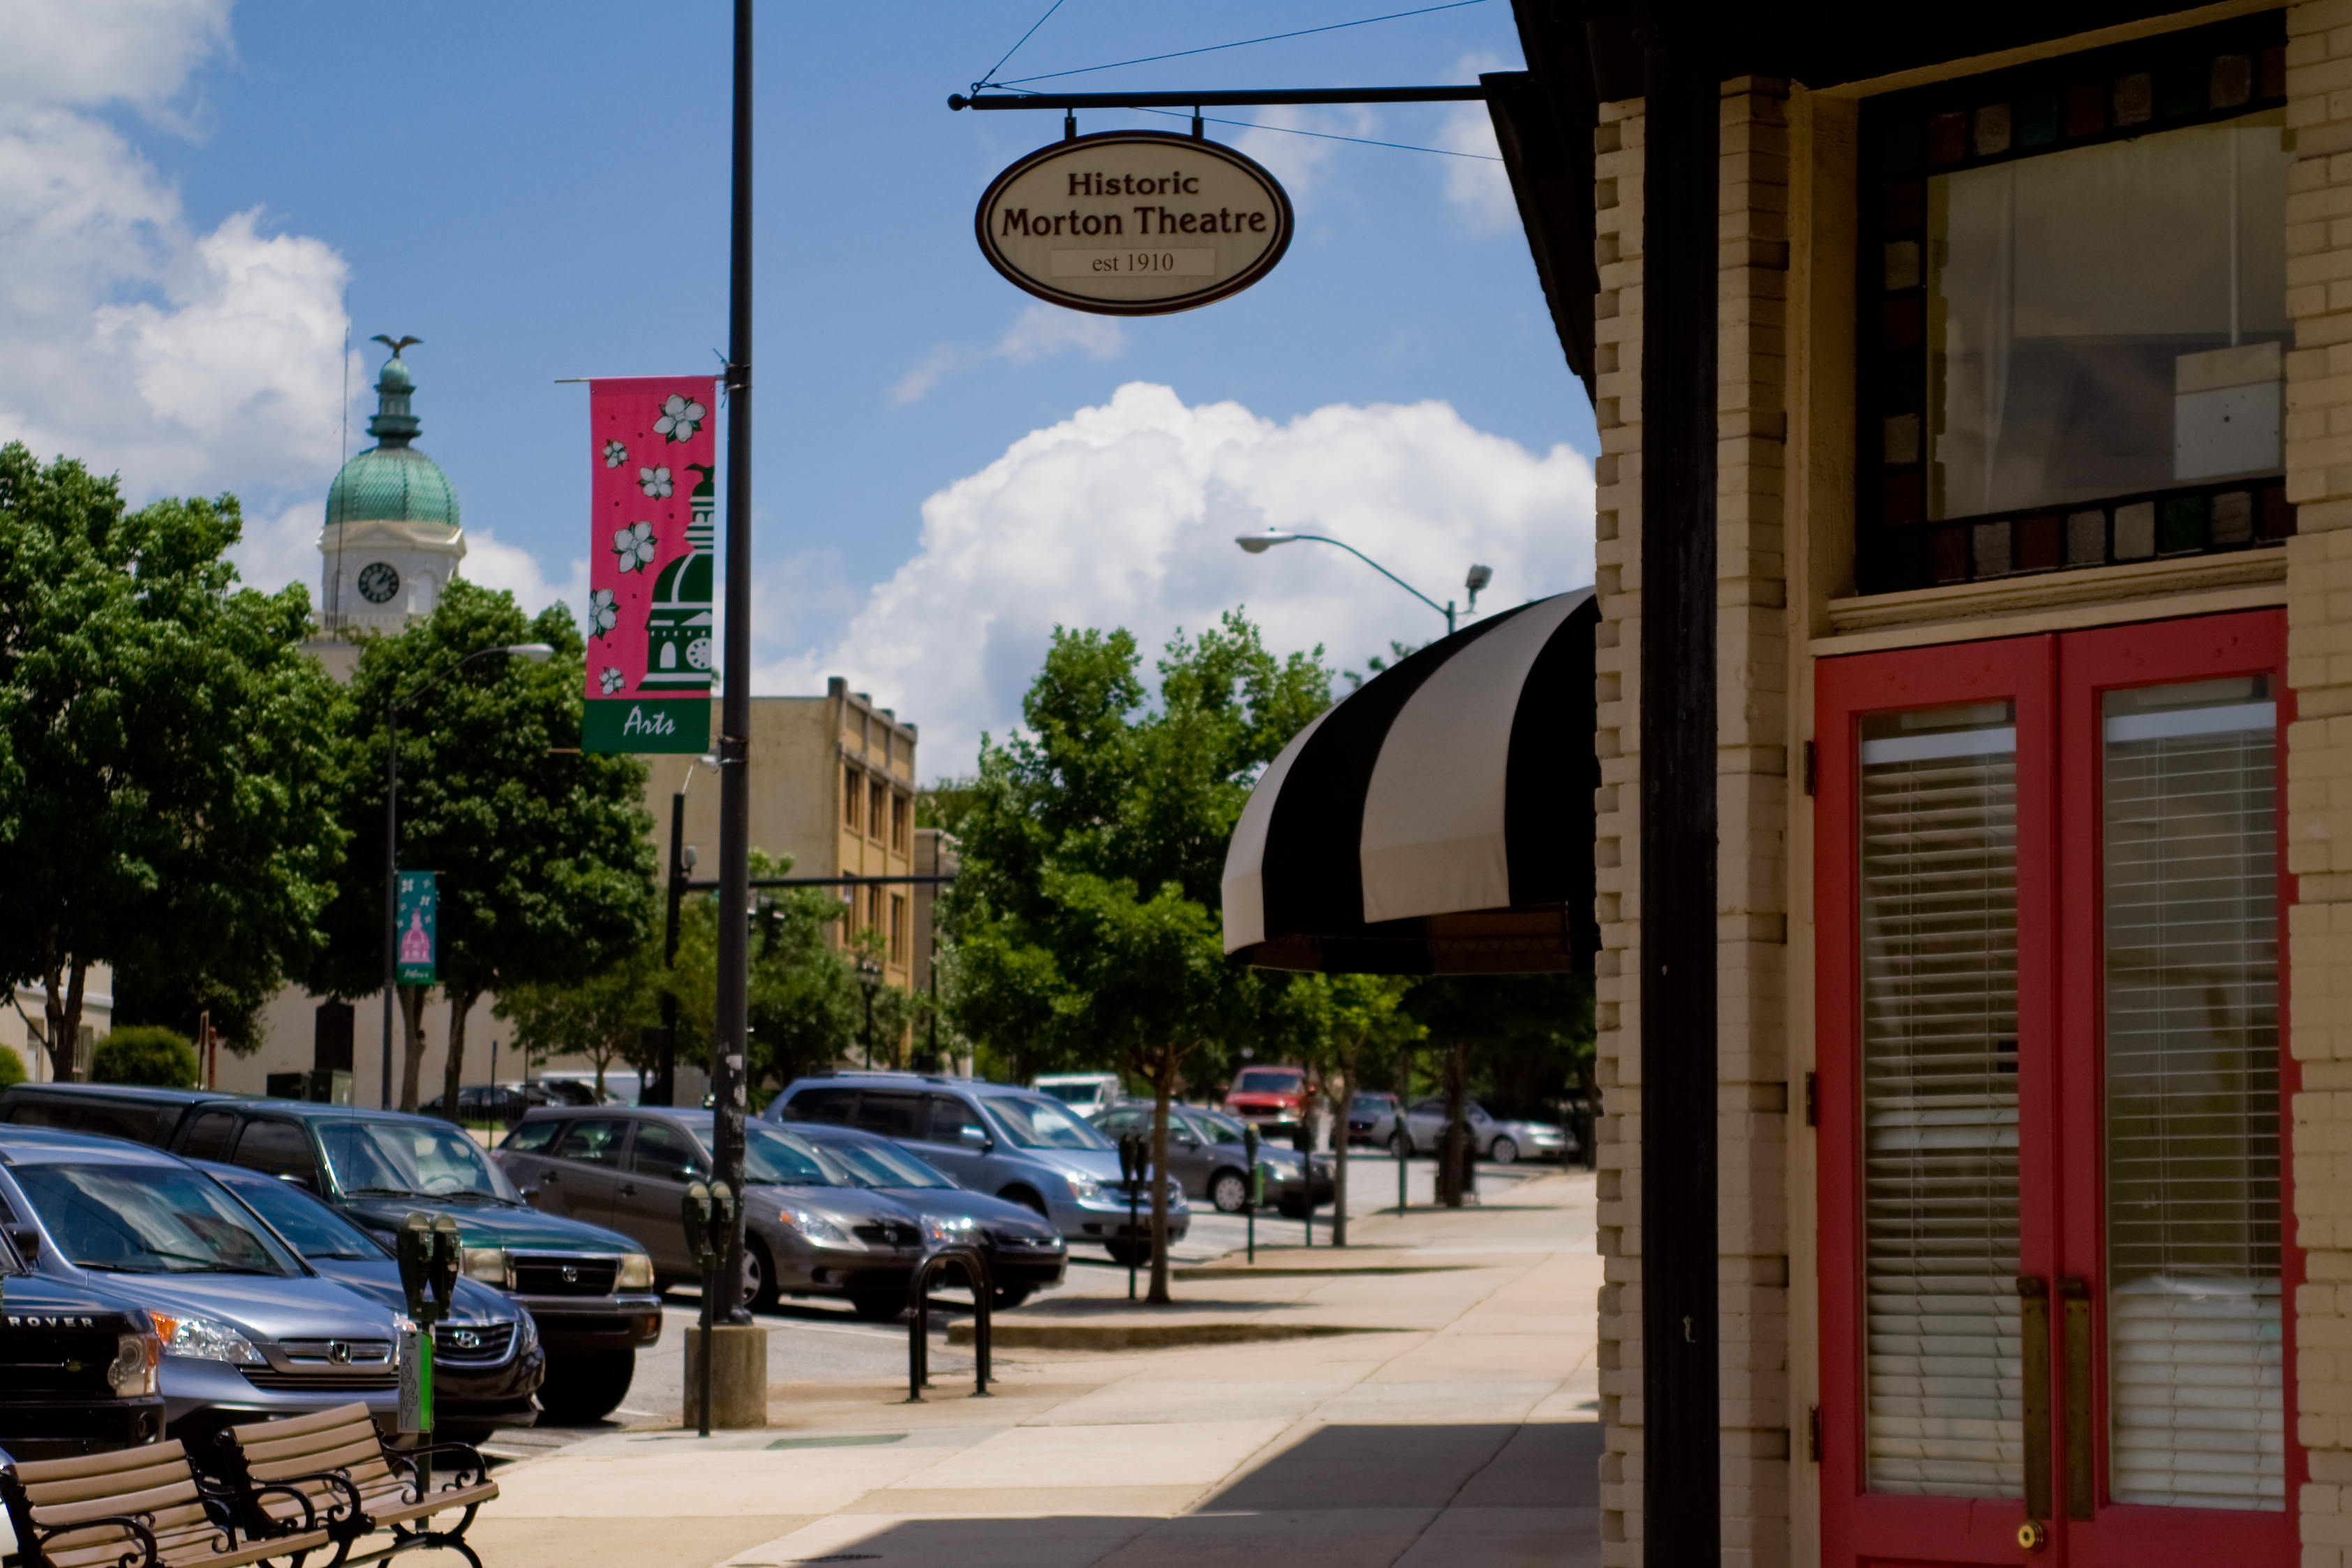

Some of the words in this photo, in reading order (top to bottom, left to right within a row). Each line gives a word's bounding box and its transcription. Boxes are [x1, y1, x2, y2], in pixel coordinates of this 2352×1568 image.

[1068, 171, 1199, 196] Historic
[1002, 209, 1122, 237] Morton
[1133, 207, 1267, 234] Theatre
[1092, 257, 1119, 271] est
[1127, 253, 1174, 271] 1910
[623, 705, 676, 736] Arts
[8, 1315, 94, 1327] ROVER
